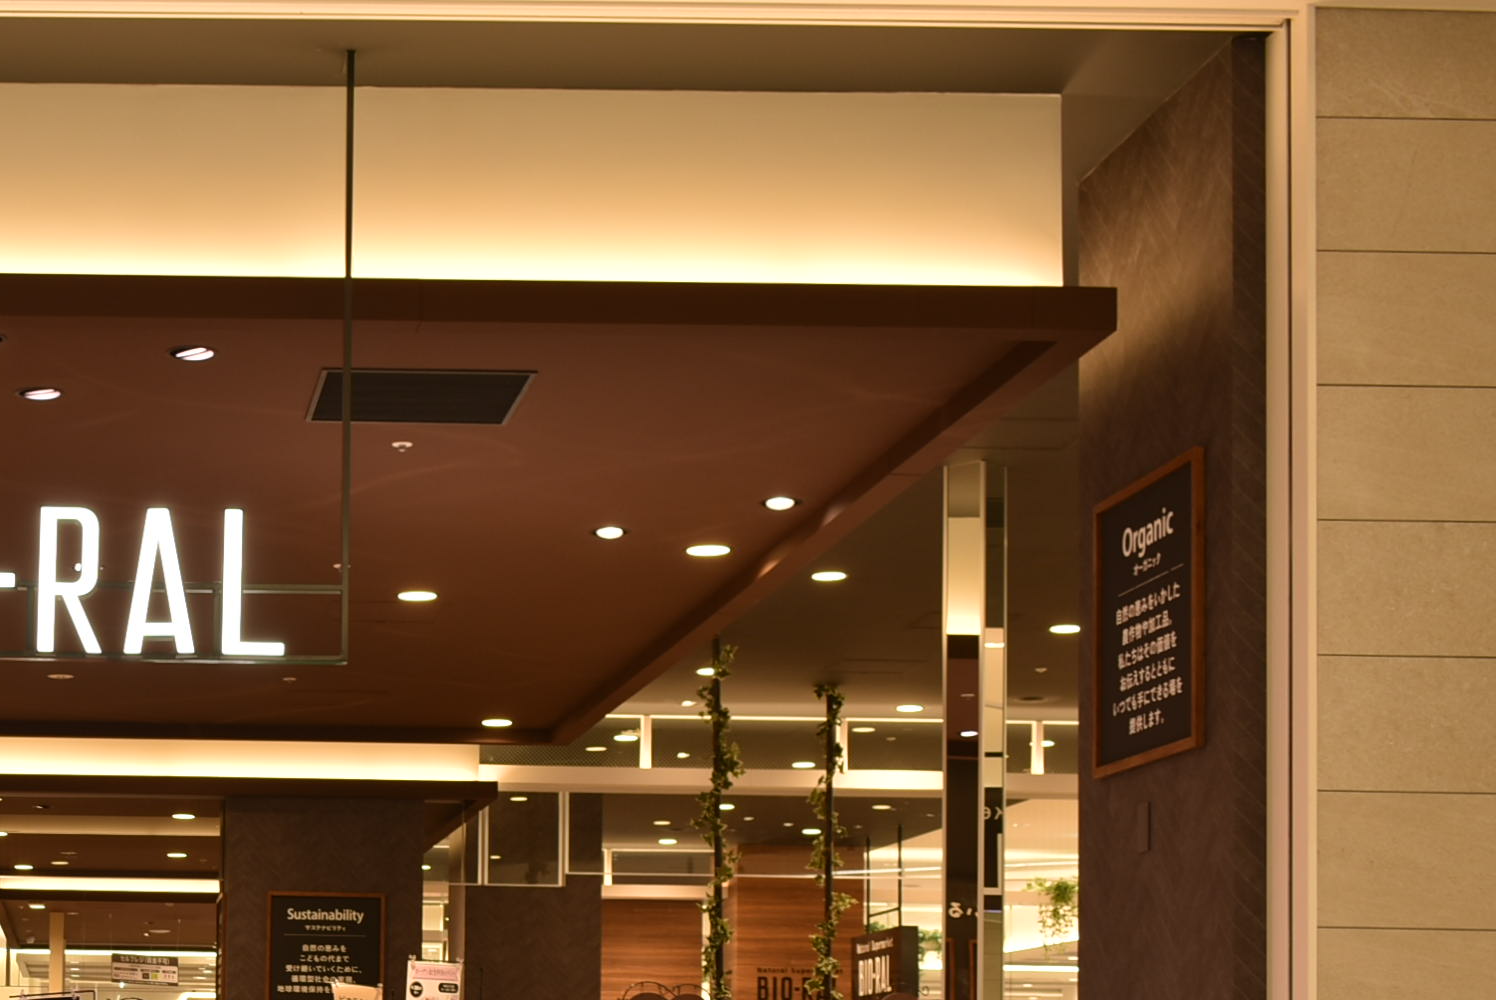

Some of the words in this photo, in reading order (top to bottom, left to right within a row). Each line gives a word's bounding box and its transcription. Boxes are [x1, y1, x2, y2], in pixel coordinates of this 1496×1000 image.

[1122, 508, 1174, 558] Organic
[287, 908, 364, 924] Sustainability
[858, 954, 892, 997] BIO-RAL
